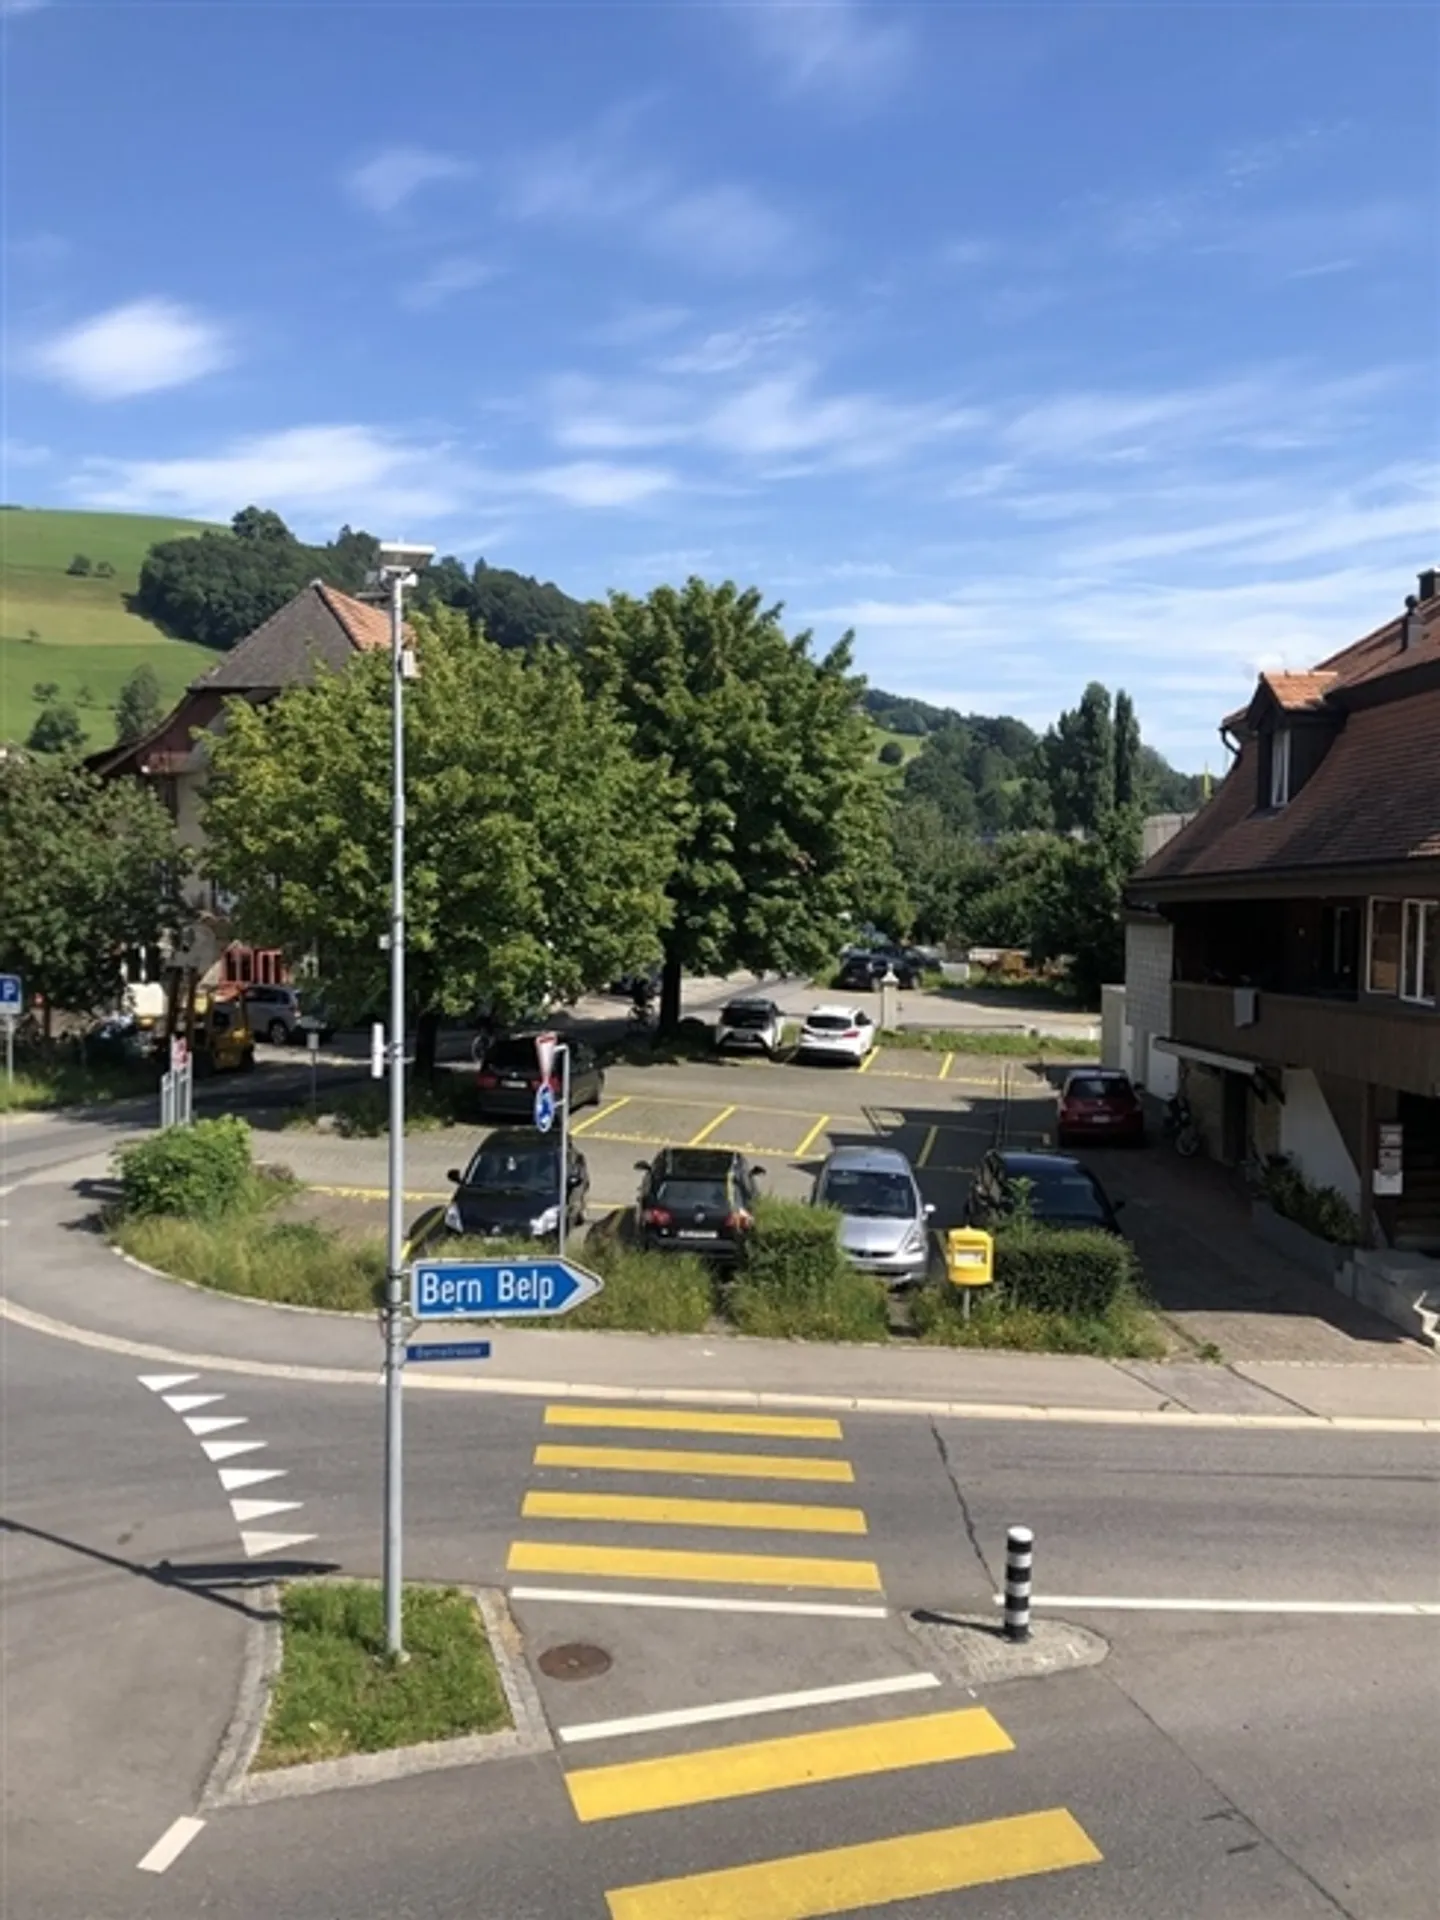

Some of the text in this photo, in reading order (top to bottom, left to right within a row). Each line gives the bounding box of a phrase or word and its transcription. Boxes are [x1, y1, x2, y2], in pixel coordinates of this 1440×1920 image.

[4, 980, 16, 998] P
[421, 1269, 554, 1309] Bern Belp
